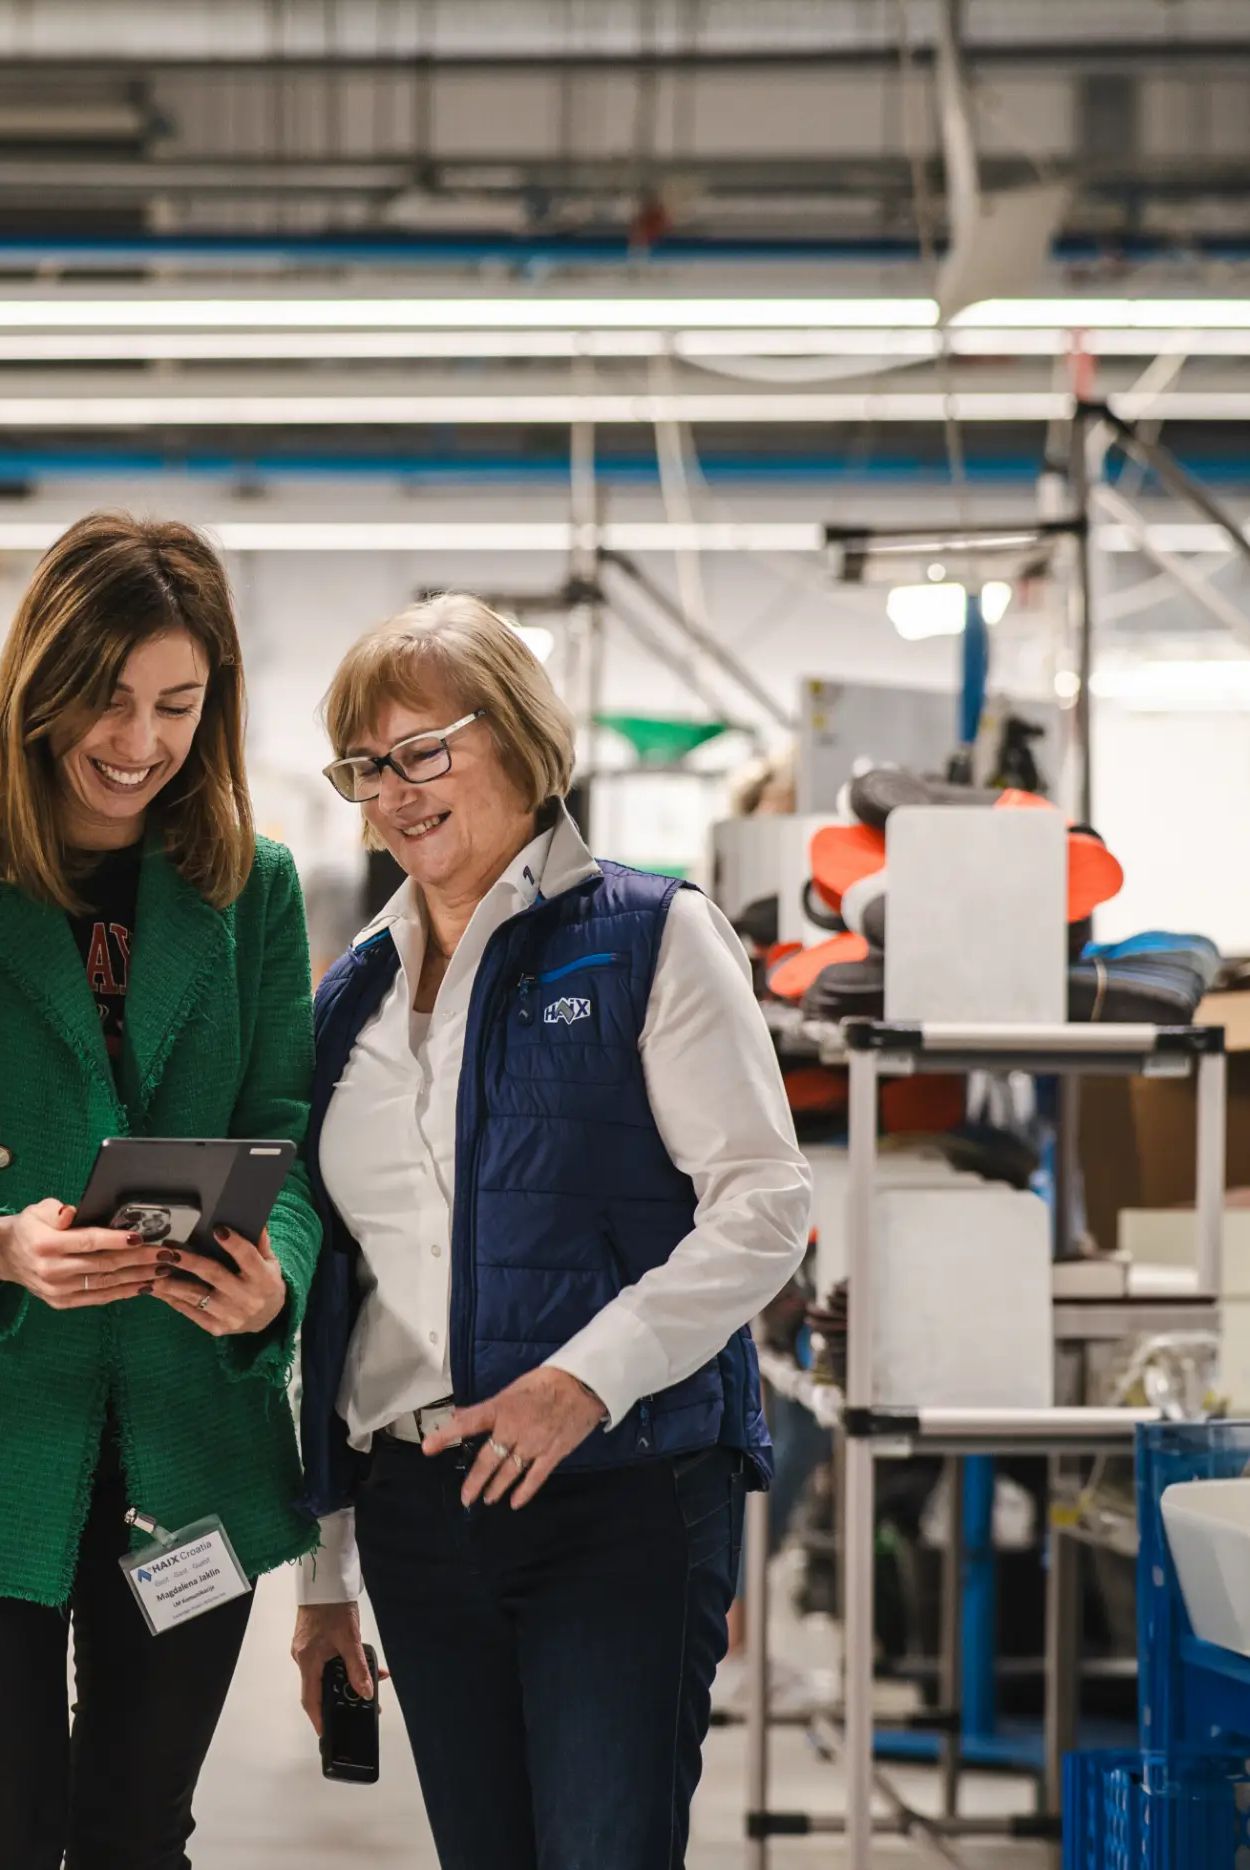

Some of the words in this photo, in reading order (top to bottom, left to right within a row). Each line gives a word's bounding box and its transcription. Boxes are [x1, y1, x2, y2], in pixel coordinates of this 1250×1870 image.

[151, 1555, 180, 1573] HAIX
[180, 1541, 212, 1560] Croatia
[156, 1579, 198, 1601] Magdalena
[198, 1568, 220, 1582] Jaklin
